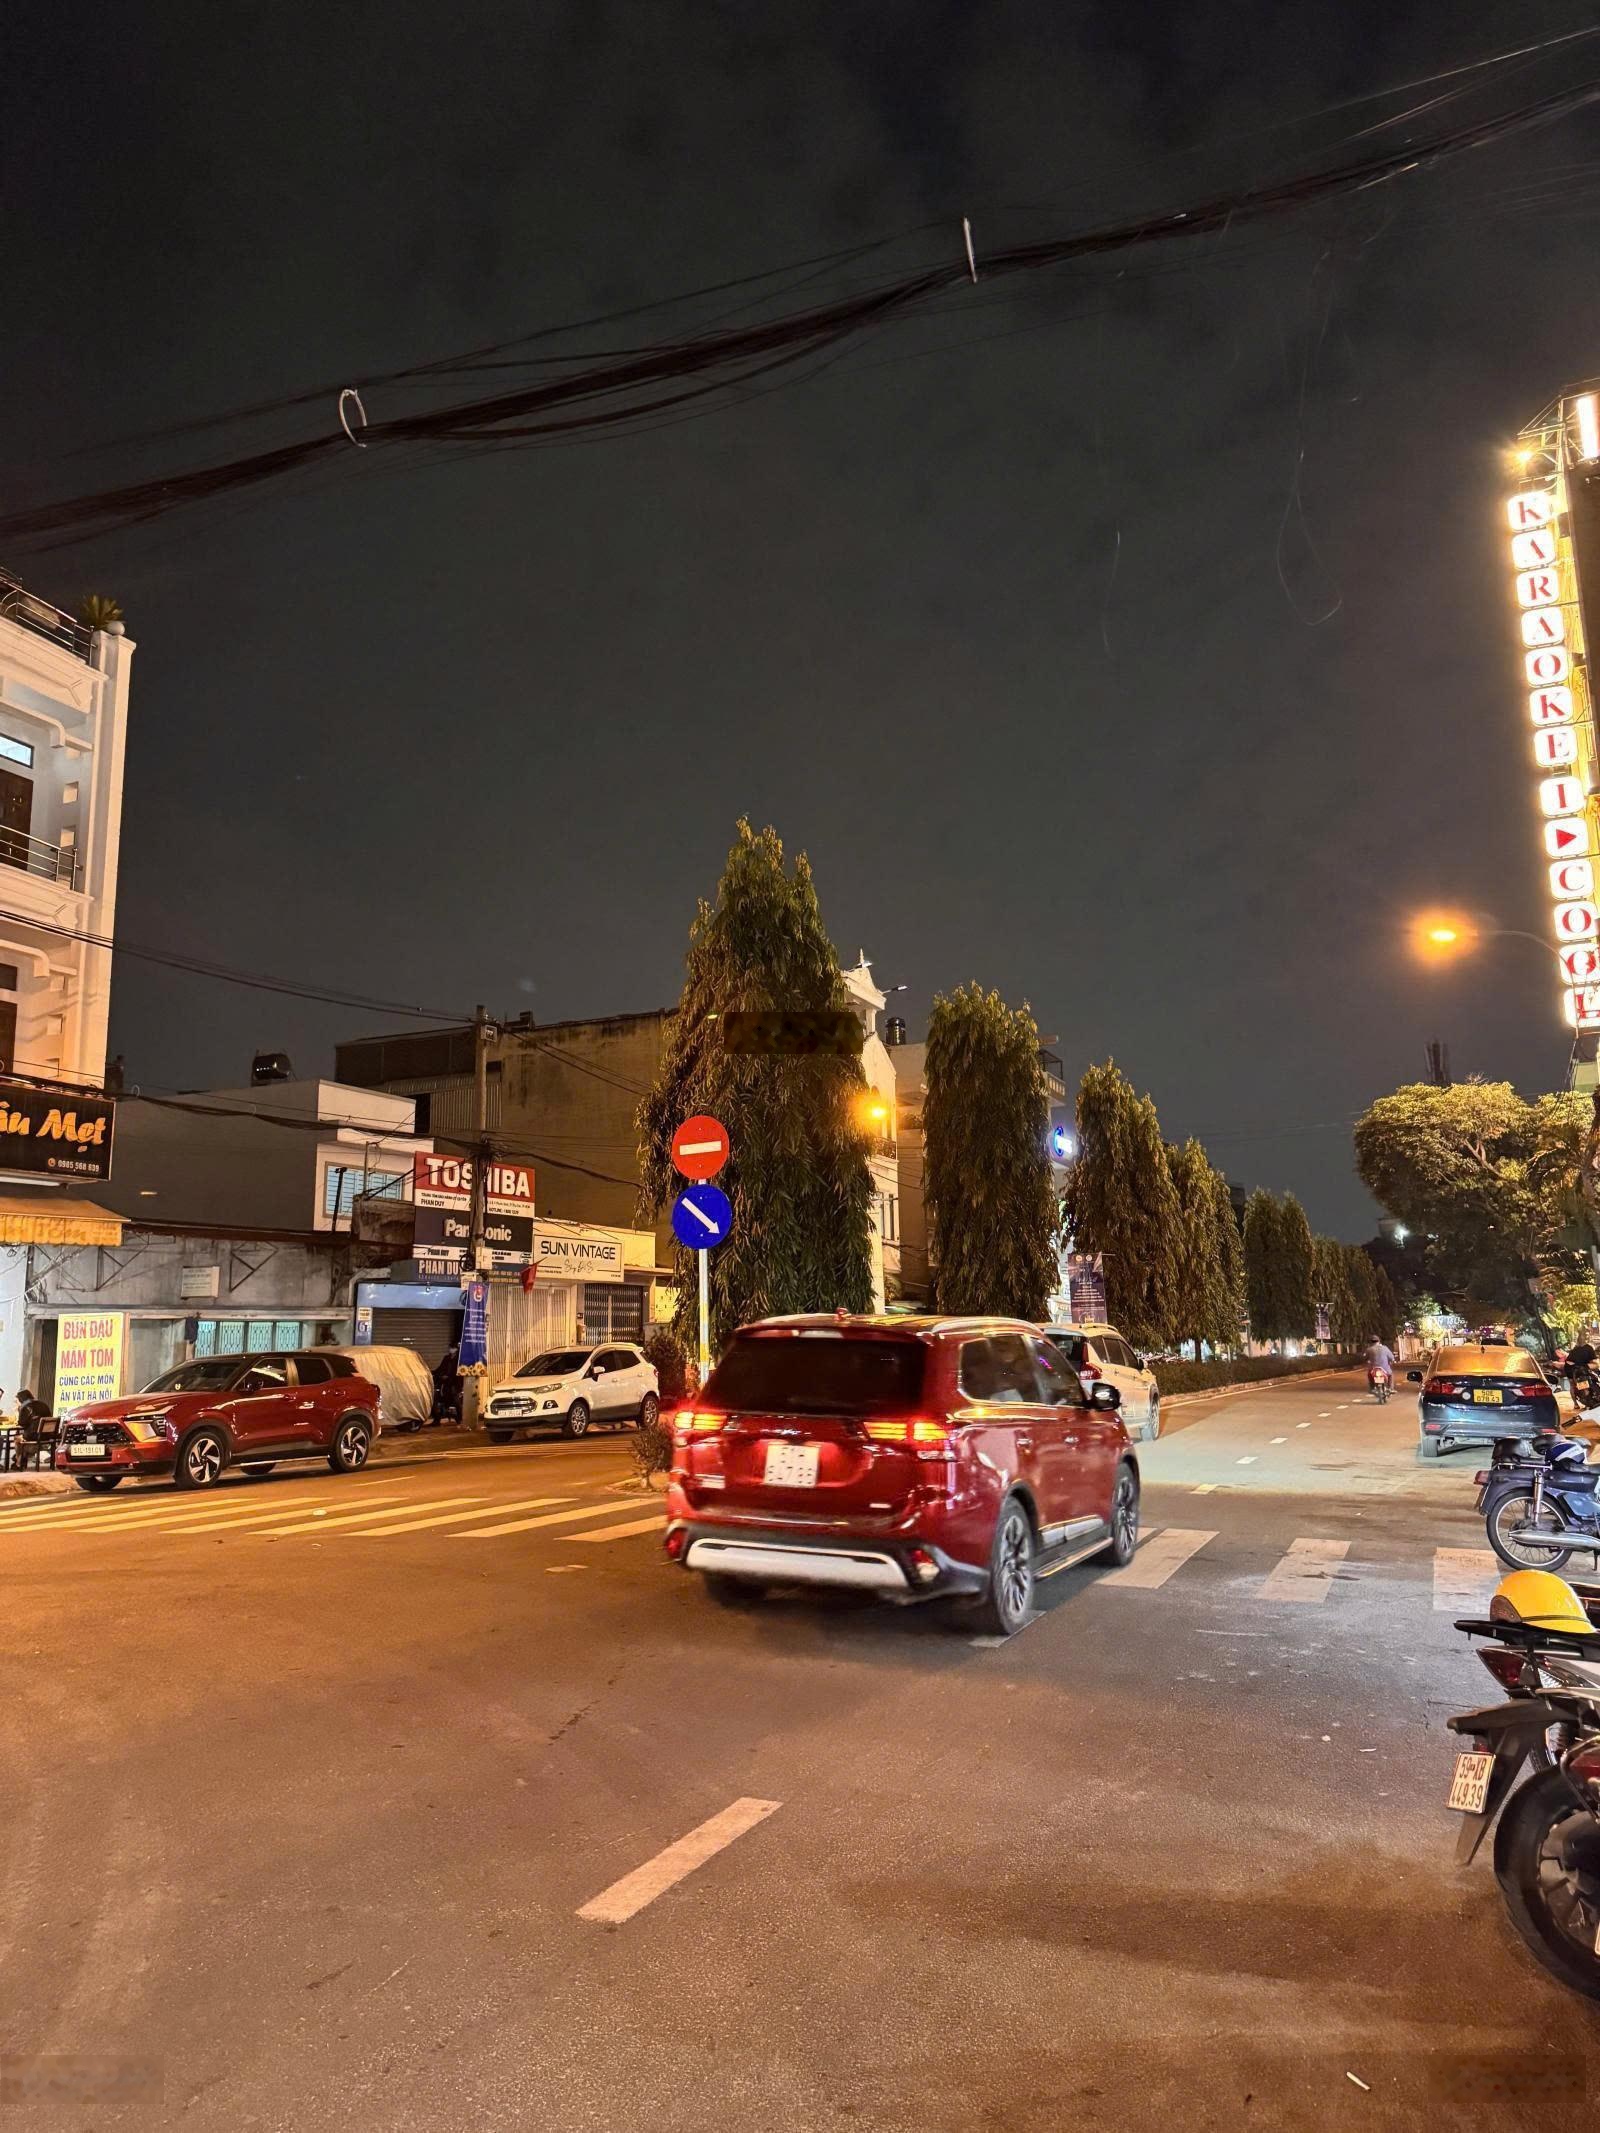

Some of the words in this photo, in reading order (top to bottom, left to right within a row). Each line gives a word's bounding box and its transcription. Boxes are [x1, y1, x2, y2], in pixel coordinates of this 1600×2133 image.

[1517, 500, 1572, 759] KARAOKE
[36, 1109, 106, 1153] Mẹt
[426, 1158, 530, 1198] TOSIBA
[444, 1218, 512, 1242] Panonic
[541, 1240, 568, 1256] SUNI
[571, 1243, 616, 1260] VINTAGE
[418, 1260, 445, 1275] PHAN
